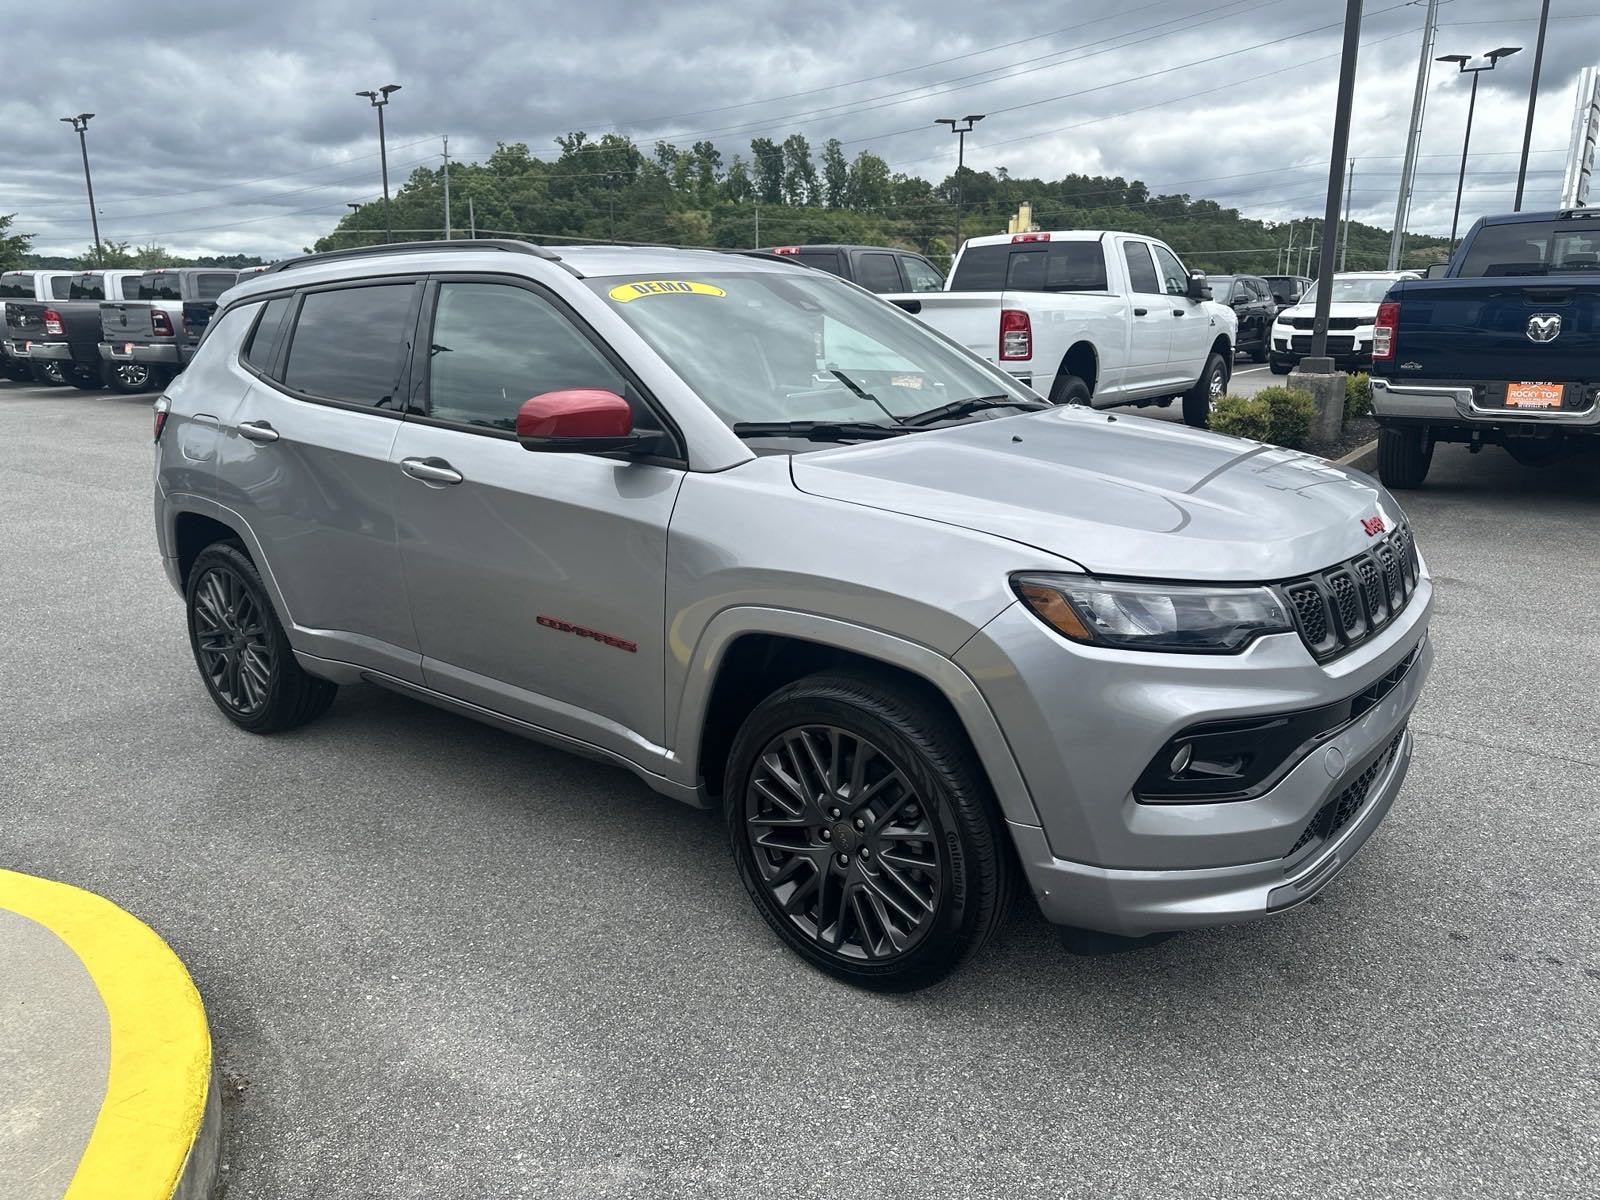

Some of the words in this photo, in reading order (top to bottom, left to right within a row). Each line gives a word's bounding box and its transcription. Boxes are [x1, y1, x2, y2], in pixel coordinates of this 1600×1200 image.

[630, 282, 693, 294] DEMO
[1360, 517, 1386, 537] Jeep
[536, 615, 637, 653] COMPASS
